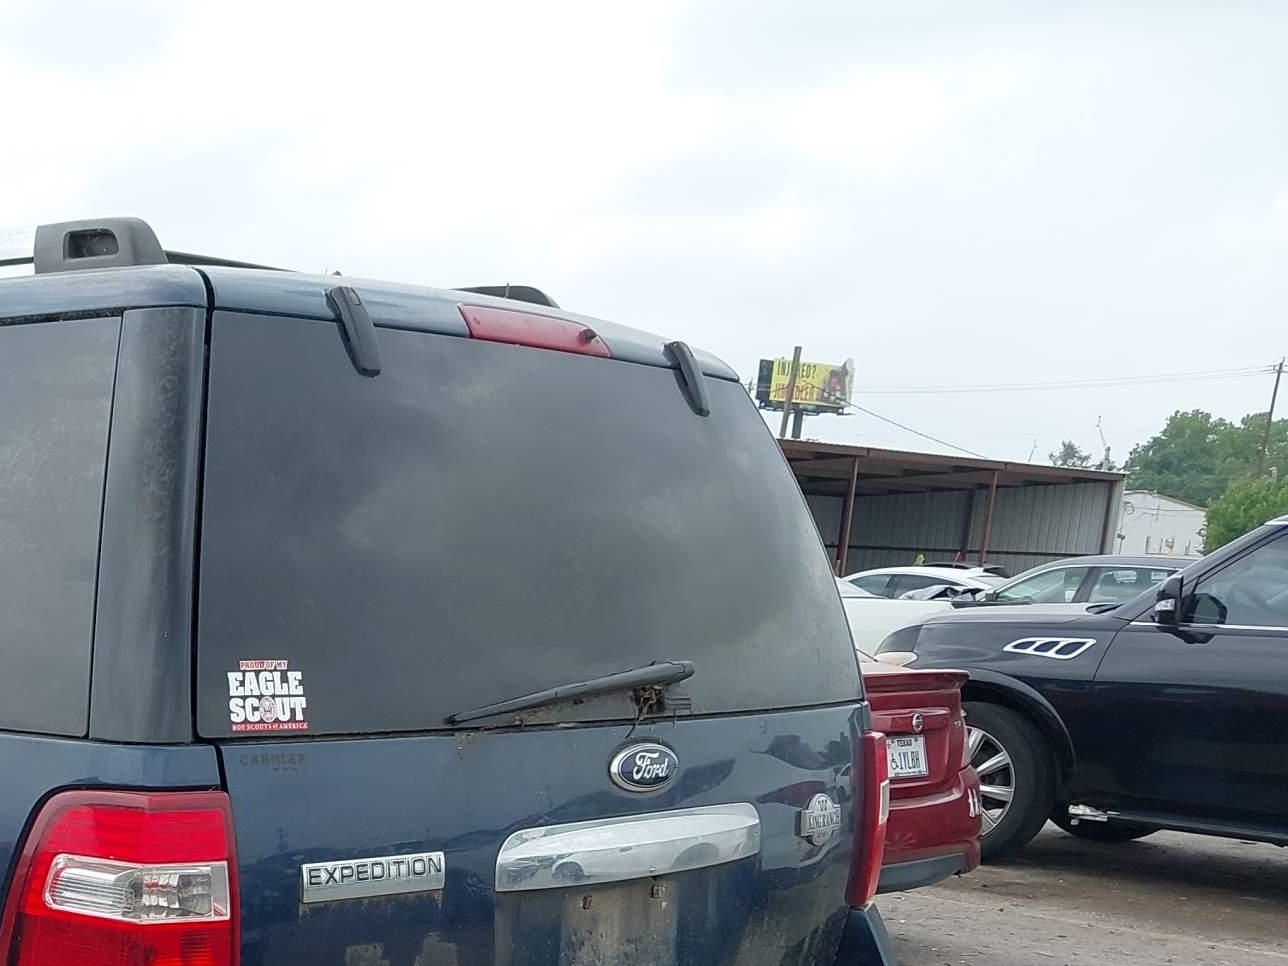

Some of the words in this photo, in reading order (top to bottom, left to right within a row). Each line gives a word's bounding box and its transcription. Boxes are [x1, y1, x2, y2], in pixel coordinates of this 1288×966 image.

[227, 671, 304, 696] EAGLE
[229, 696, 307, 723] SCOUT
[279, 722, 309, 730] AMERICA
[896, 739, 913, 748] TEXAS
[632, 752, 669, 780] Ford
[307, 856, 442, 886] EXPEDITION
